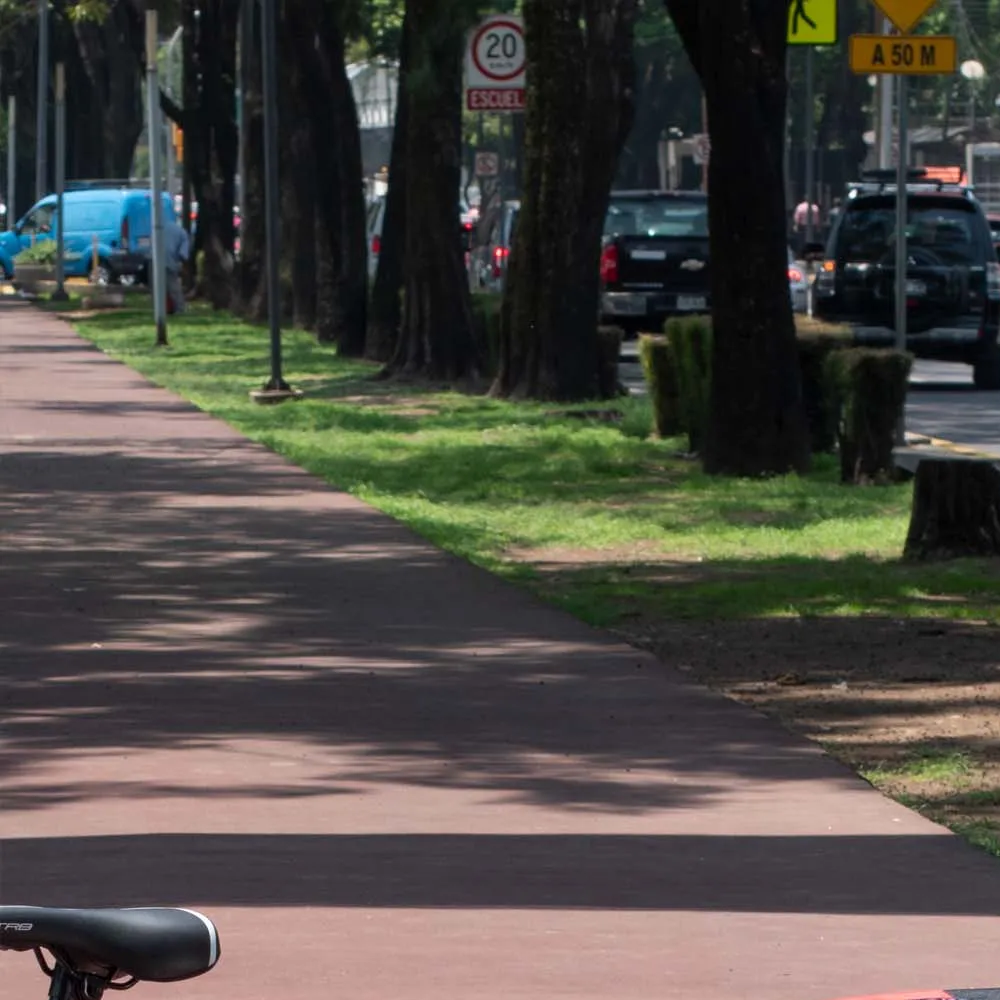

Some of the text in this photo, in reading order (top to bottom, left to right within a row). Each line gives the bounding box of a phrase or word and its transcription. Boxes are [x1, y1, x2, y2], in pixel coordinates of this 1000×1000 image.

[485, 32, 517, 59] 20
[871, 43, 936, 67] A 50 M
[470, 90, 526, 109] ESCUEL
